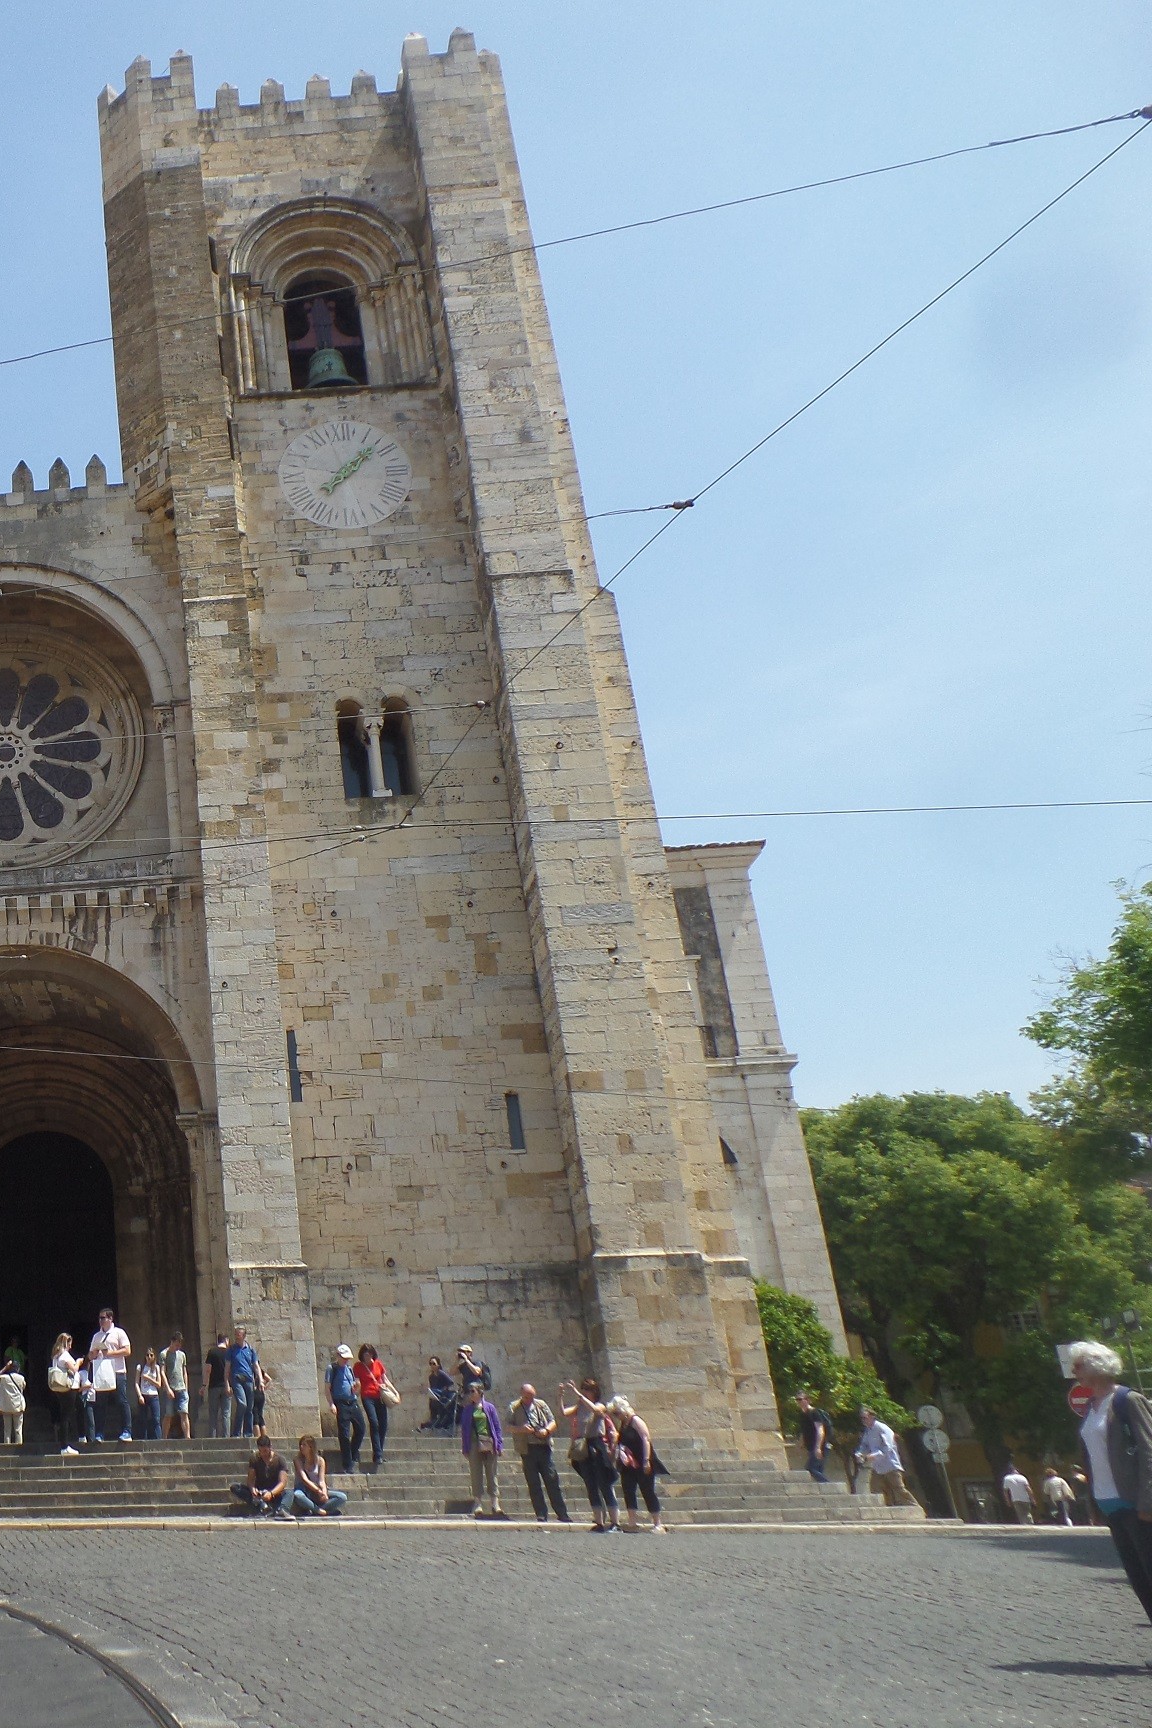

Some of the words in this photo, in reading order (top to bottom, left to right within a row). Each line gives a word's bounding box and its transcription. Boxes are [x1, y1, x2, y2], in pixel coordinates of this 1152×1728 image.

[331, 422, 350, 445] XII
[377, 443, 397, 457] II
[385, 465, 408, 476] III
